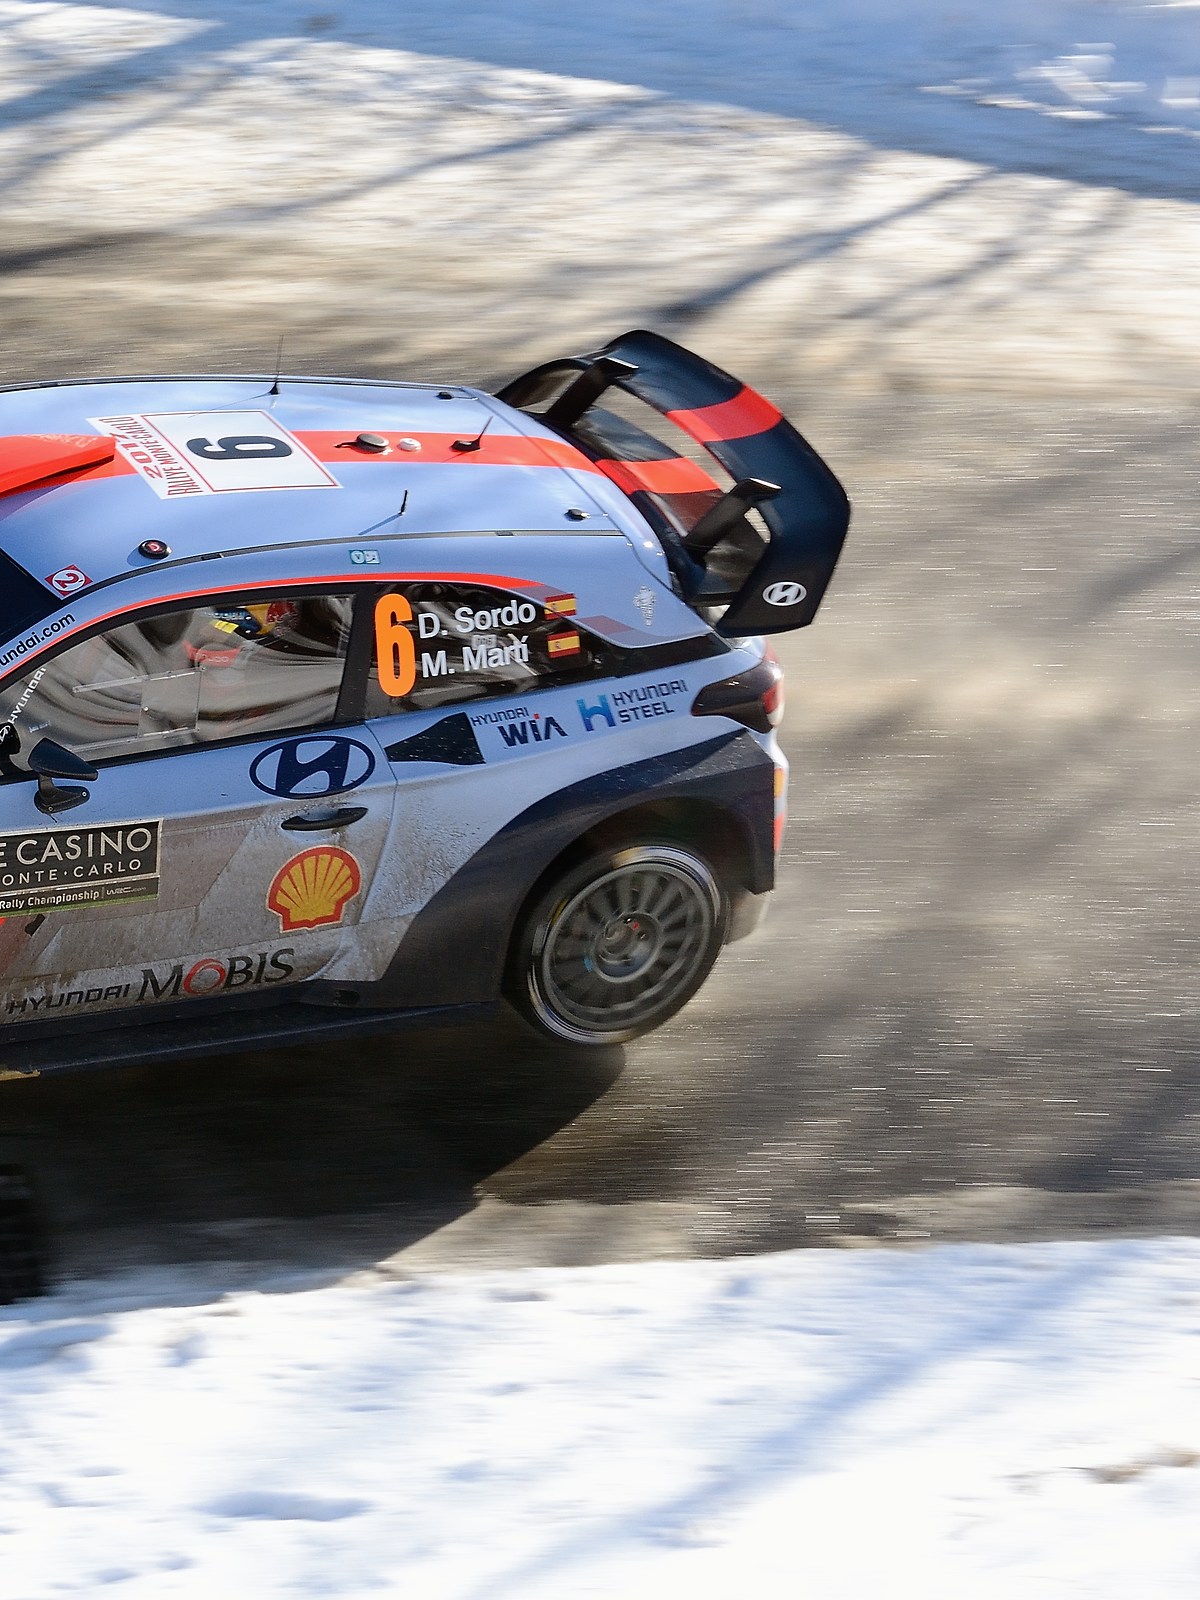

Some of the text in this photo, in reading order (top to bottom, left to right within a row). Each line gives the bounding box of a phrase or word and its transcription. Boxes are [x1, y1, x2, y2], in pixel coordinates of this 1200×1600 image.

[98, 416, 204, 496] RALLYE MONTE-CARLO
[53, 572, 79, 589] 2
[418, 599, 536, 640] D. Sordo
[374, 593, 417, 697] 6
[421, 635, 530, 678] M. Martí
[7, 667, 47, 725] HYUNDAI
[612, 679, 688, 706] HYUNDAI
[617, 701, 675, 723] STEEL
[469, 706, 530, 727] HYUNDAI
[16, 828, 152, 866] CASINO
[27, 888, 100, 907] Championship
[4, 948, 296, 1015] HYUNDAI MOBIS
